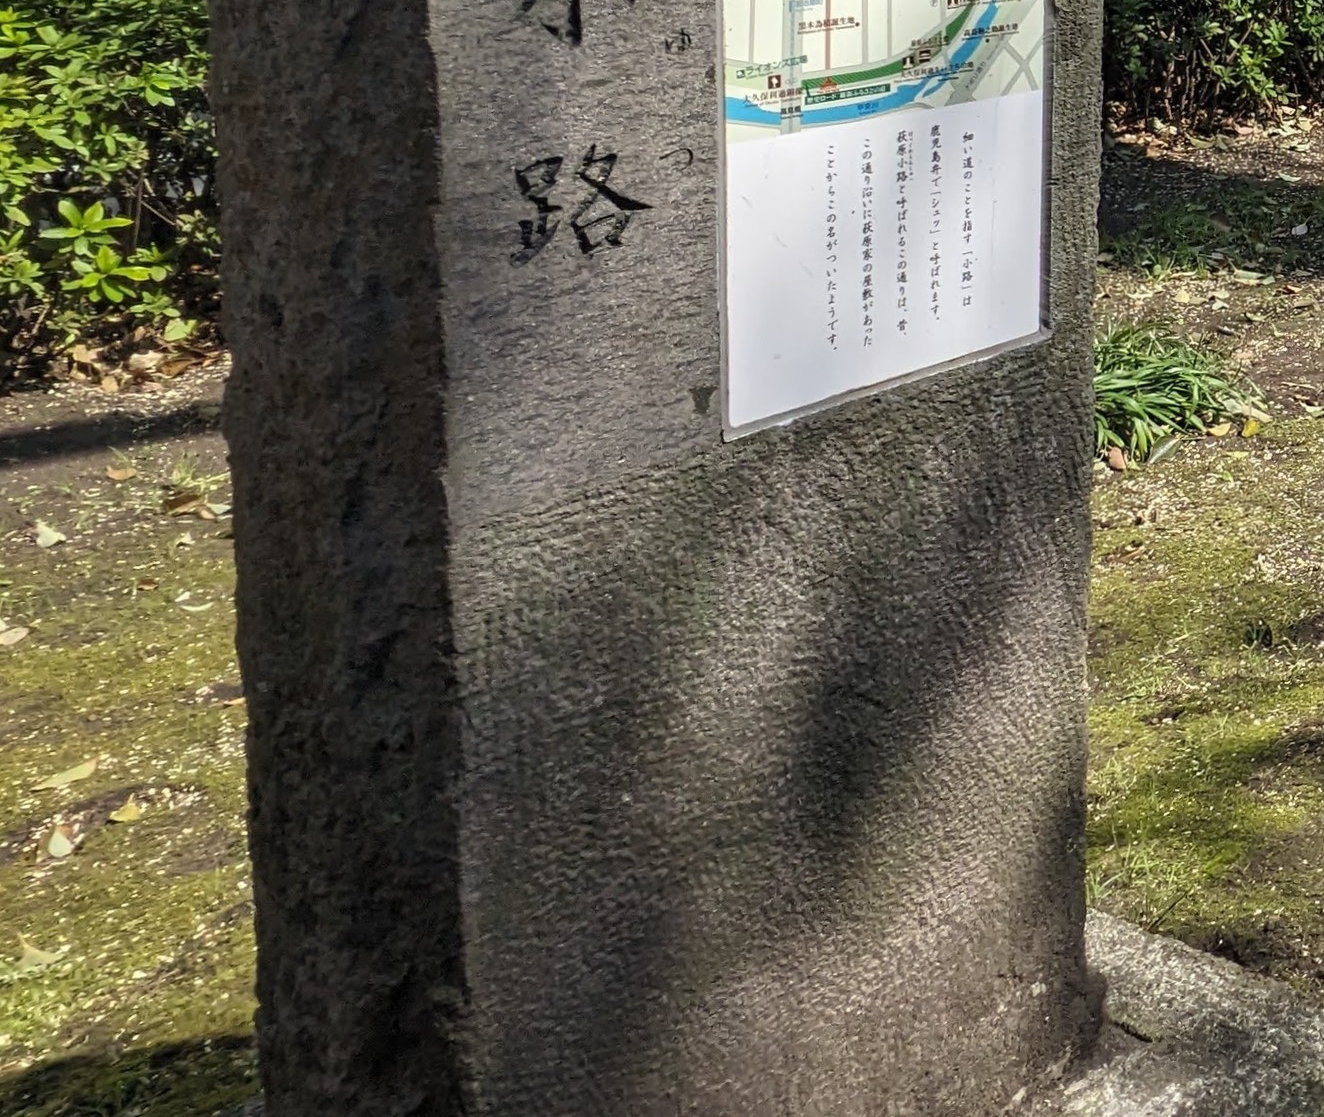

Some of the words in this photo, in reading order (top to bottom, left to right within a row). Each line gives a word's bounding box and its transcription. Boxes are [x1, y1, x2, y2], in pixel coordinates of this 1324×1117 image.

[960, 131, 975, 307] 細い道のことを指す「小路」は
